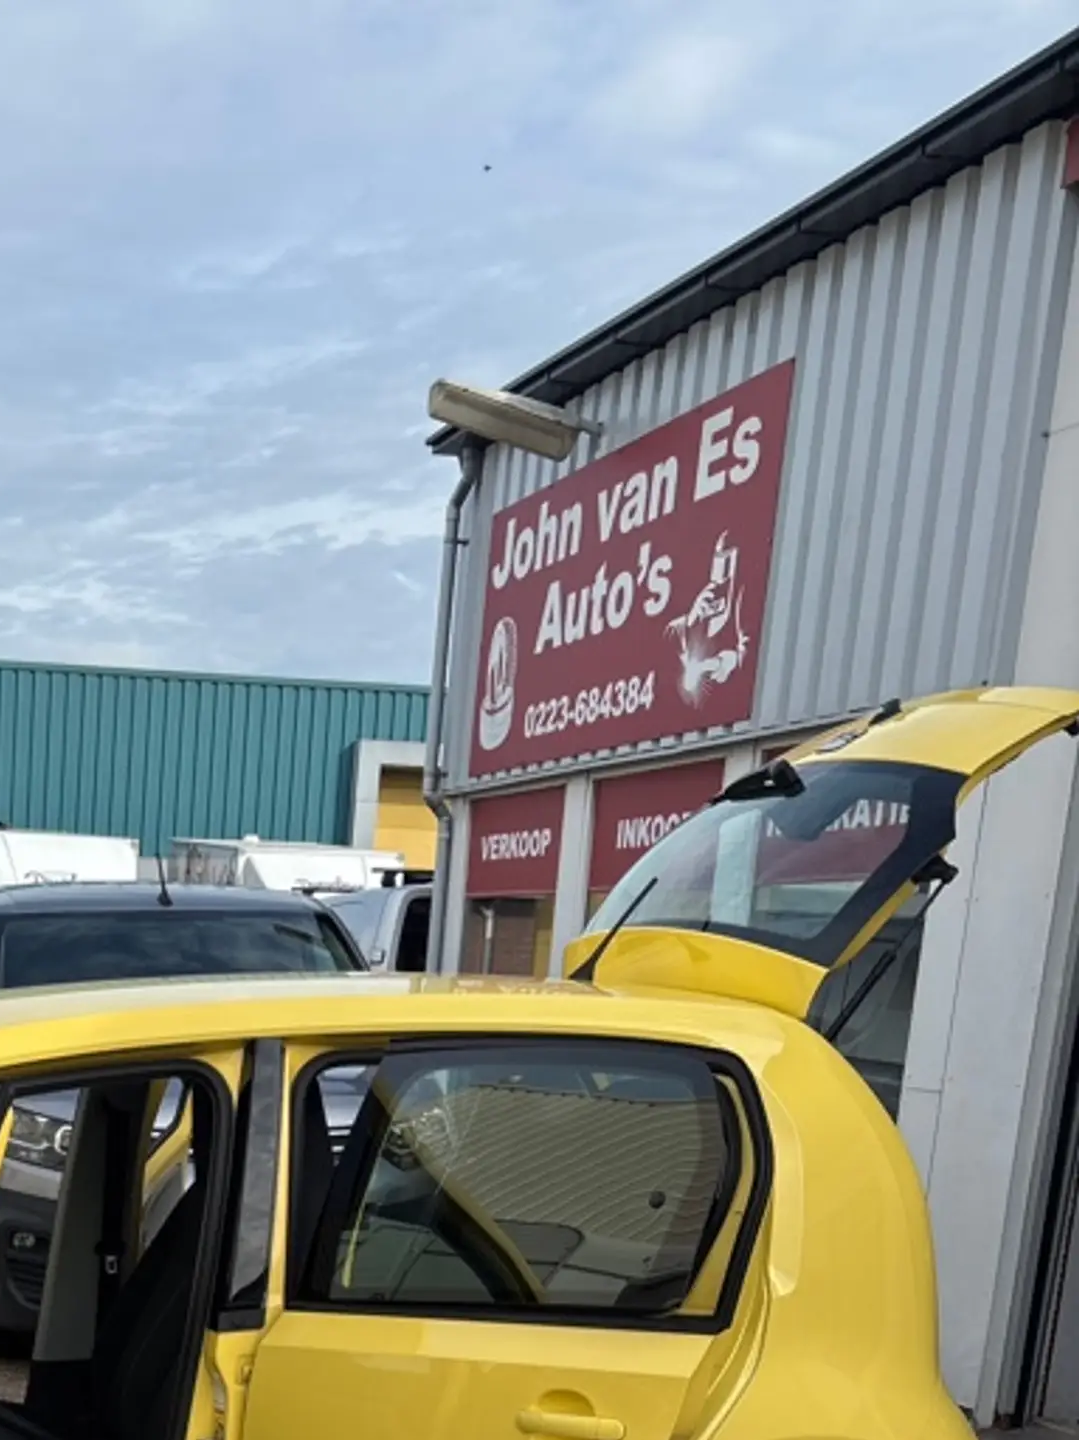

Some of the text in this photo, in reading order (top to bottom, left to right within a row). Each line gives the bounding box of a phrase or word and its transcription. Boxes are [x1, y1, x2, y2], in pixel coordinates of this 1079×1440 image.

[492, 406, 762, 589] John van Es
[533, 541, 673, 654] Auto's
[524, 671, 656, 738] 0223-684384
[481, 828, 551, 861] VERKOOP
[617, 811, 691, 849] INKOO
